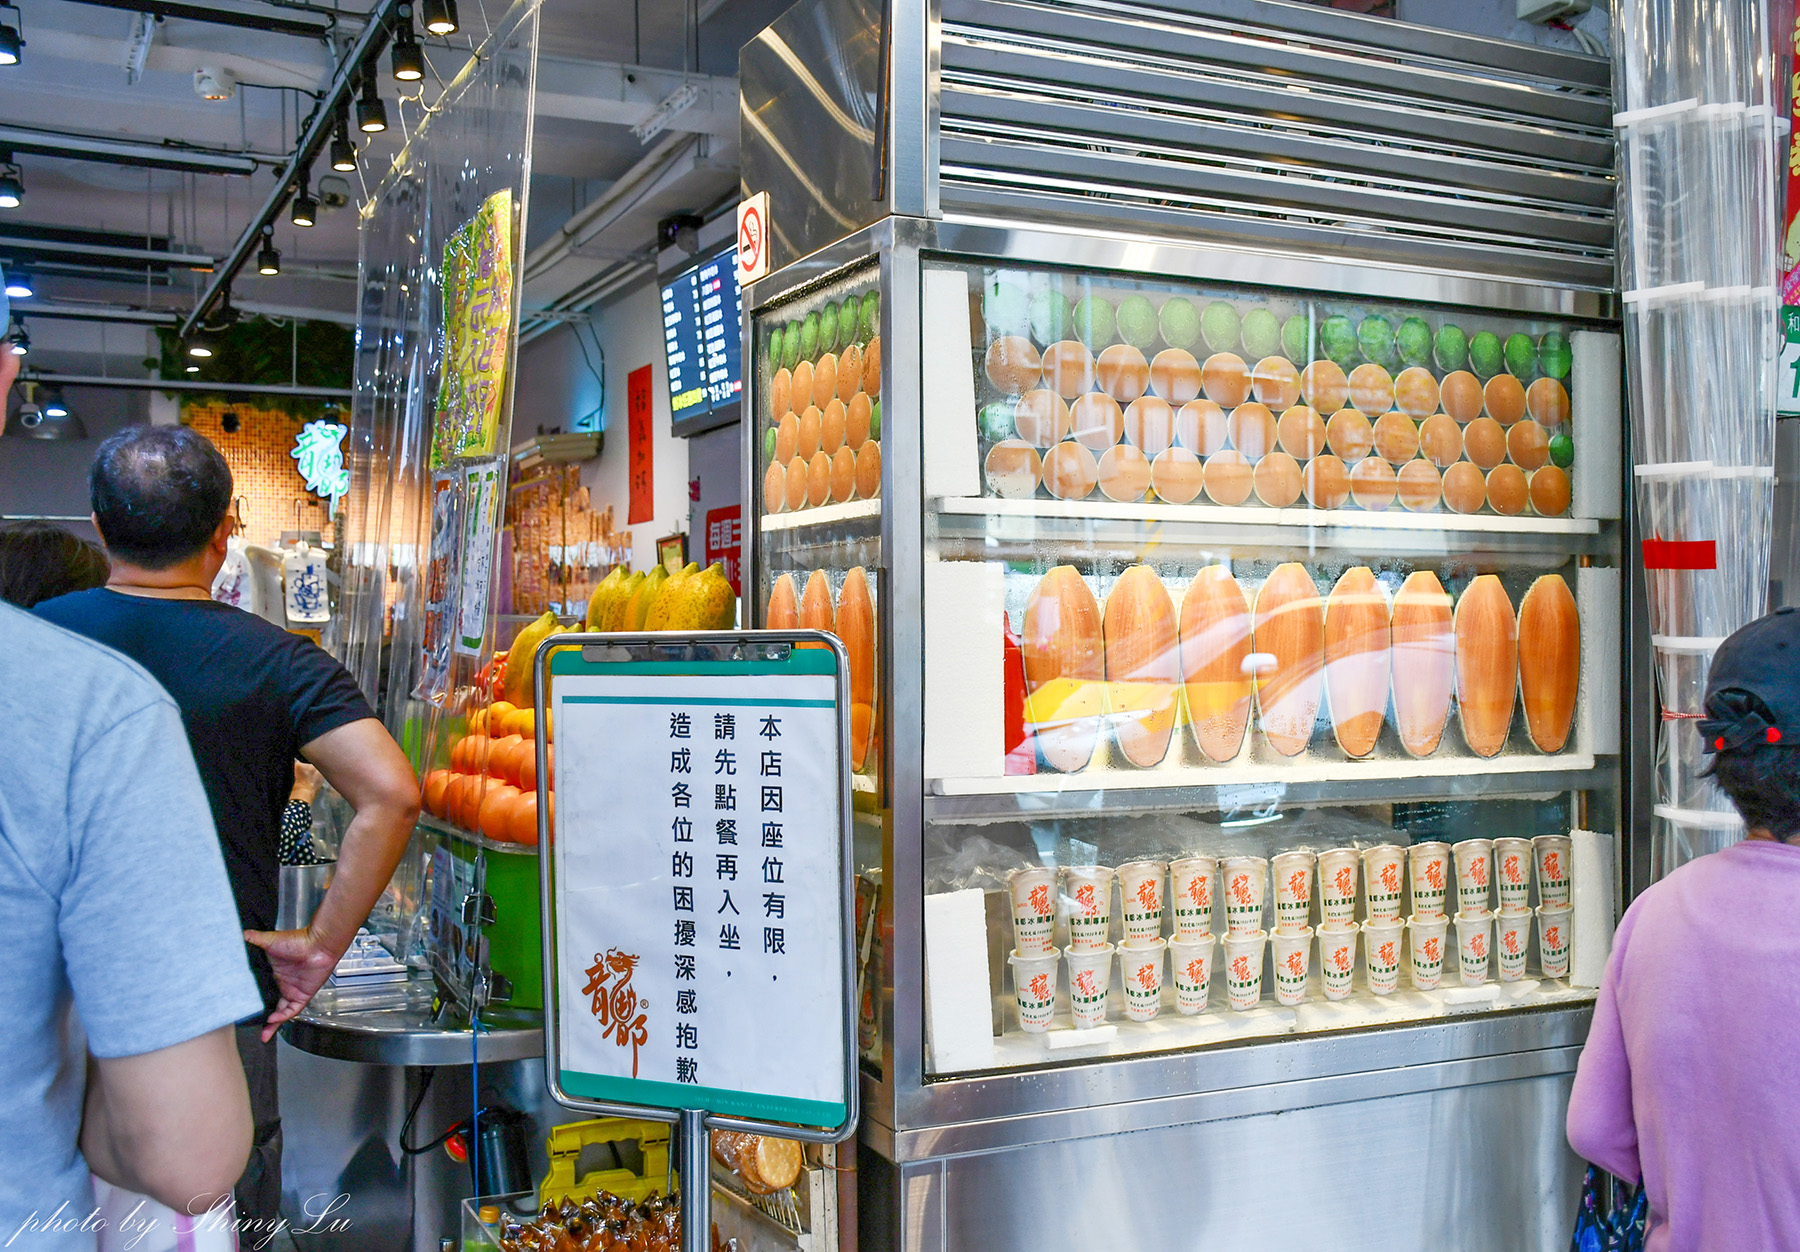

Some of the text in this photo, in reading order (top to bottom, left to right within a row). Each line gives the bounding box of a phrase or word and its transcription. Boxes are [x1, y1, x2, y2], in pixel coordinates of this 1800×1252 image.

[669, 711, 698, 1085] 造成各位的困擾深感抱歉
